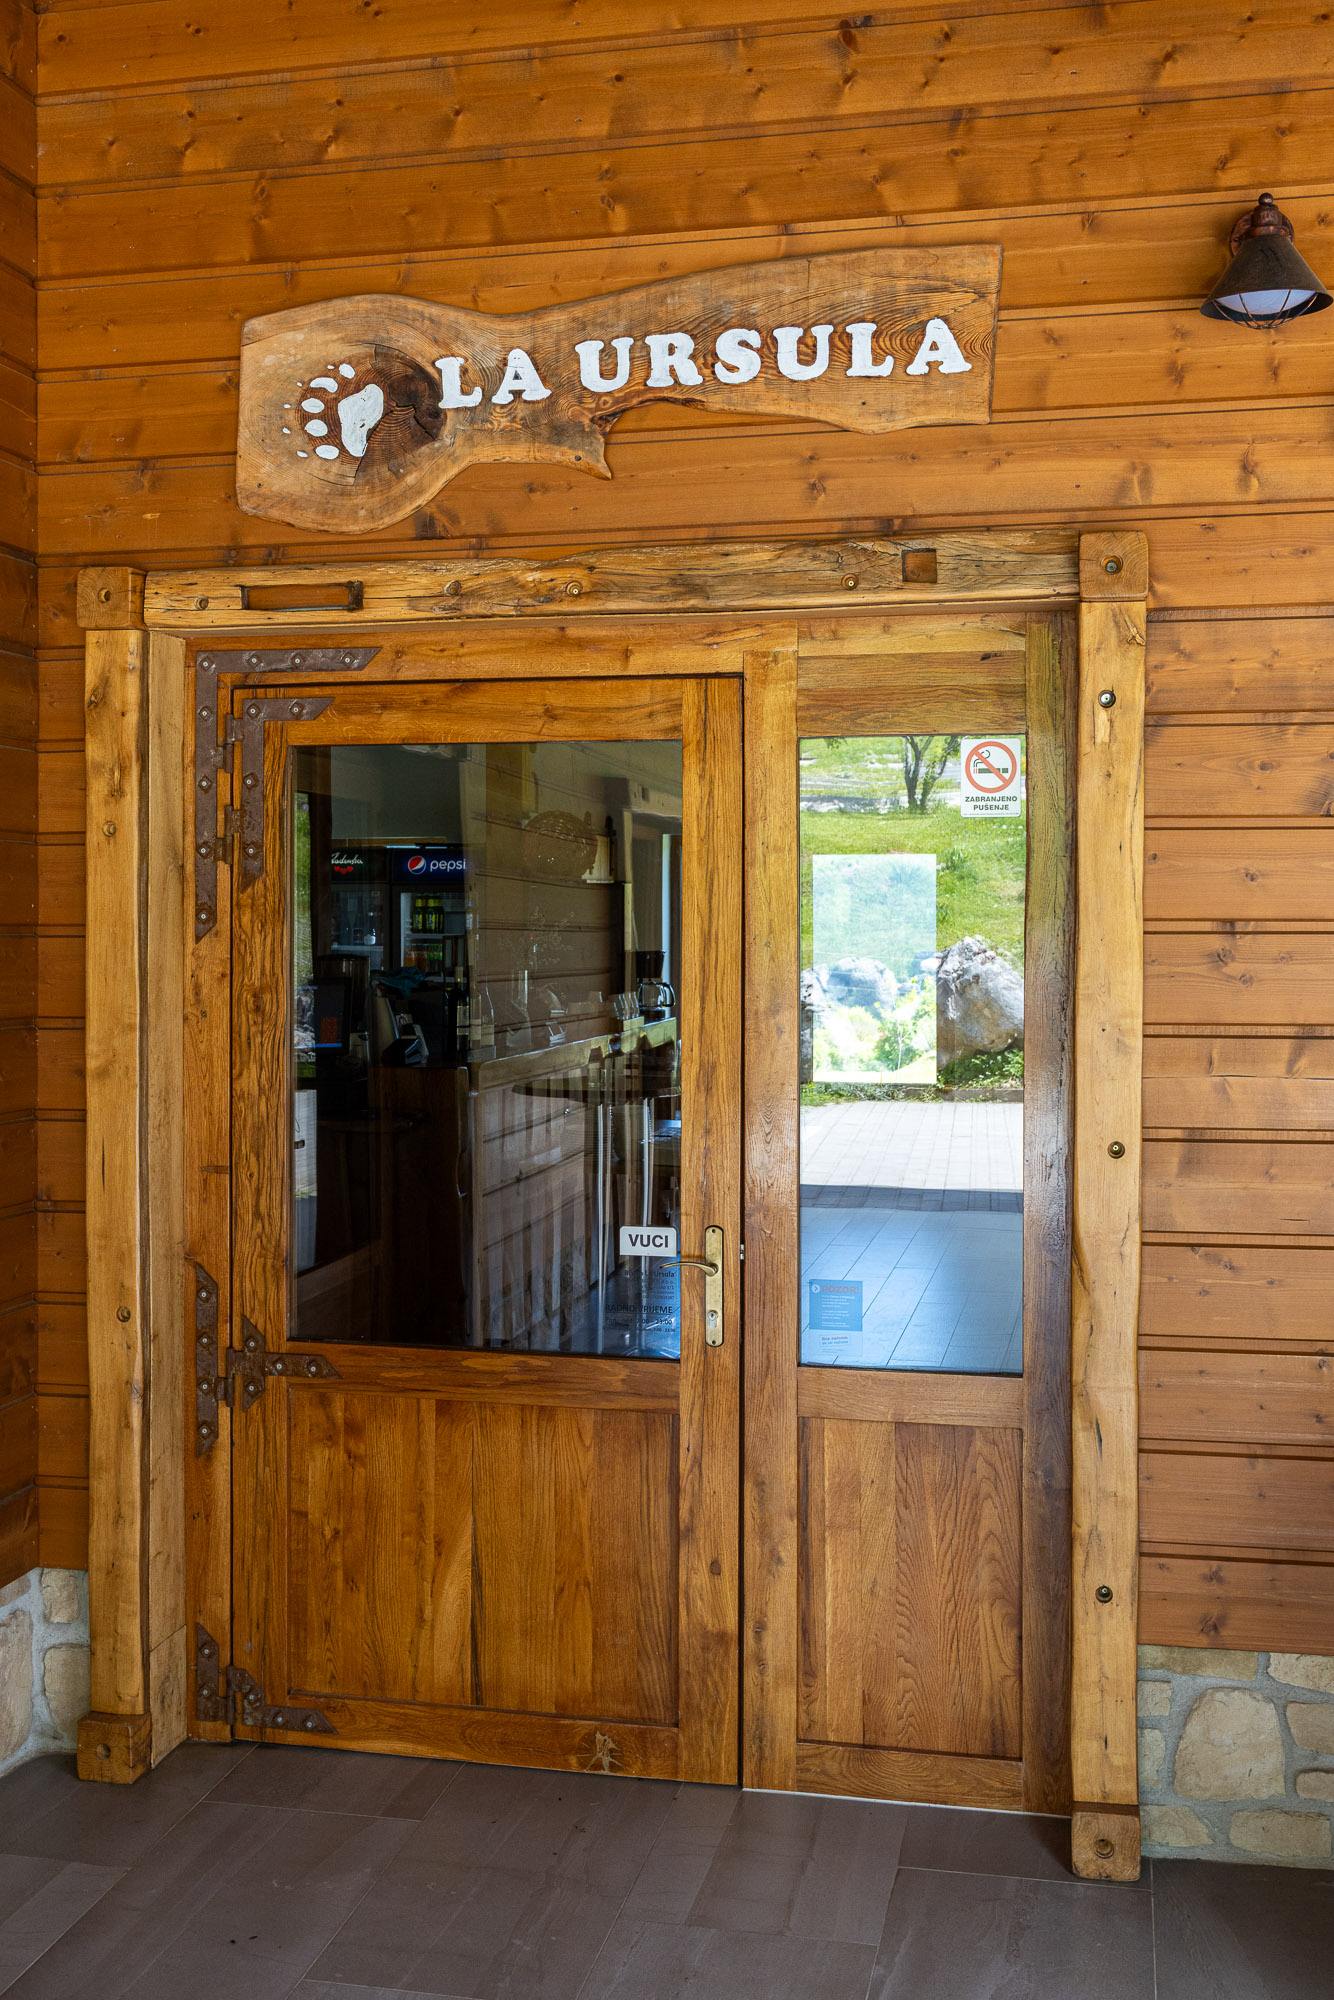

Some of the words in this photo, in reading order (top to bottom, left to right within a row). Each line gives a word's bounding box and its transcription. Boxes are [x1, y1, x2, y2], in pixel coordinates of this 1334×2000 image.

[434, 348, 552, 409] LA
[575, 317, 971, 393] URSULA
[973, 803, 1009, 811] PUŠENJE
[430, 858, 466, 872] pepsi
[628, 1234, 669, 1248] VUCI
